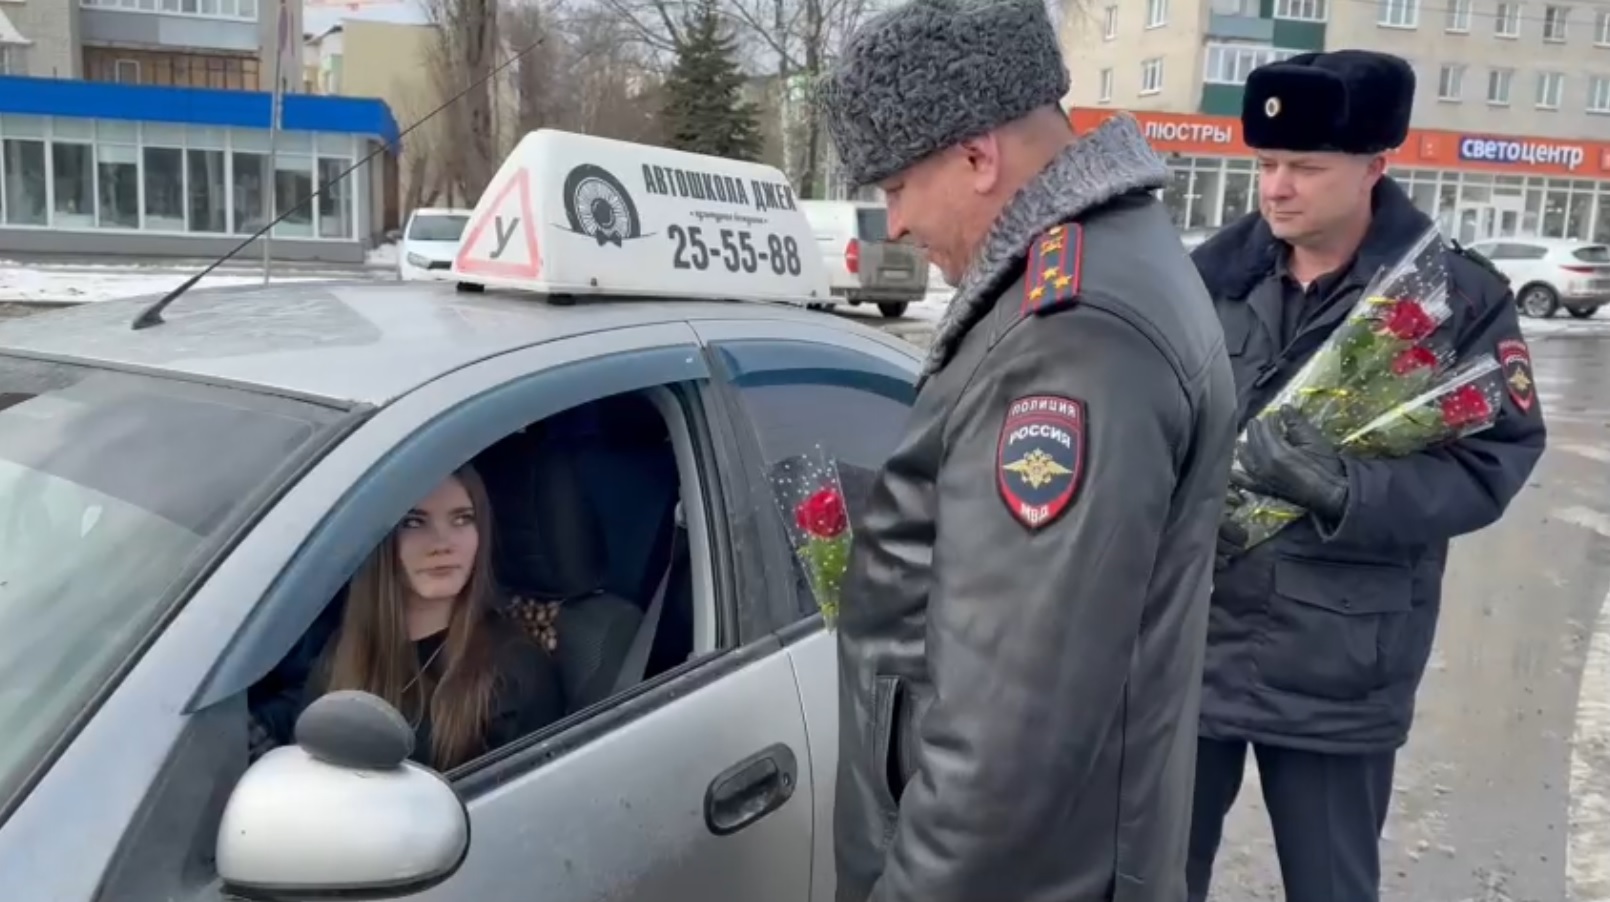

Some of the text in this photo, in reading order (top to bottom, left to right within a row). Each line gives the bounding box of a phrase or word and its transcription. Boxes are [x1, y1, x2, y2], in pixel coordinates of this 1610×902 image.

[1145, 121, 1232, 143] ЛЮСТРЫ
[642, 163, 798, 213] АВТОШКОЛА ДЖЕК
[667, 223, 801, 277] 25-55-88
[1011, 399, 1076, 418] ПОЛИЦИЯ
[1009, 424, 1071, 449] РОССИЯ
[1020, 502, 1049, 524] МВД
